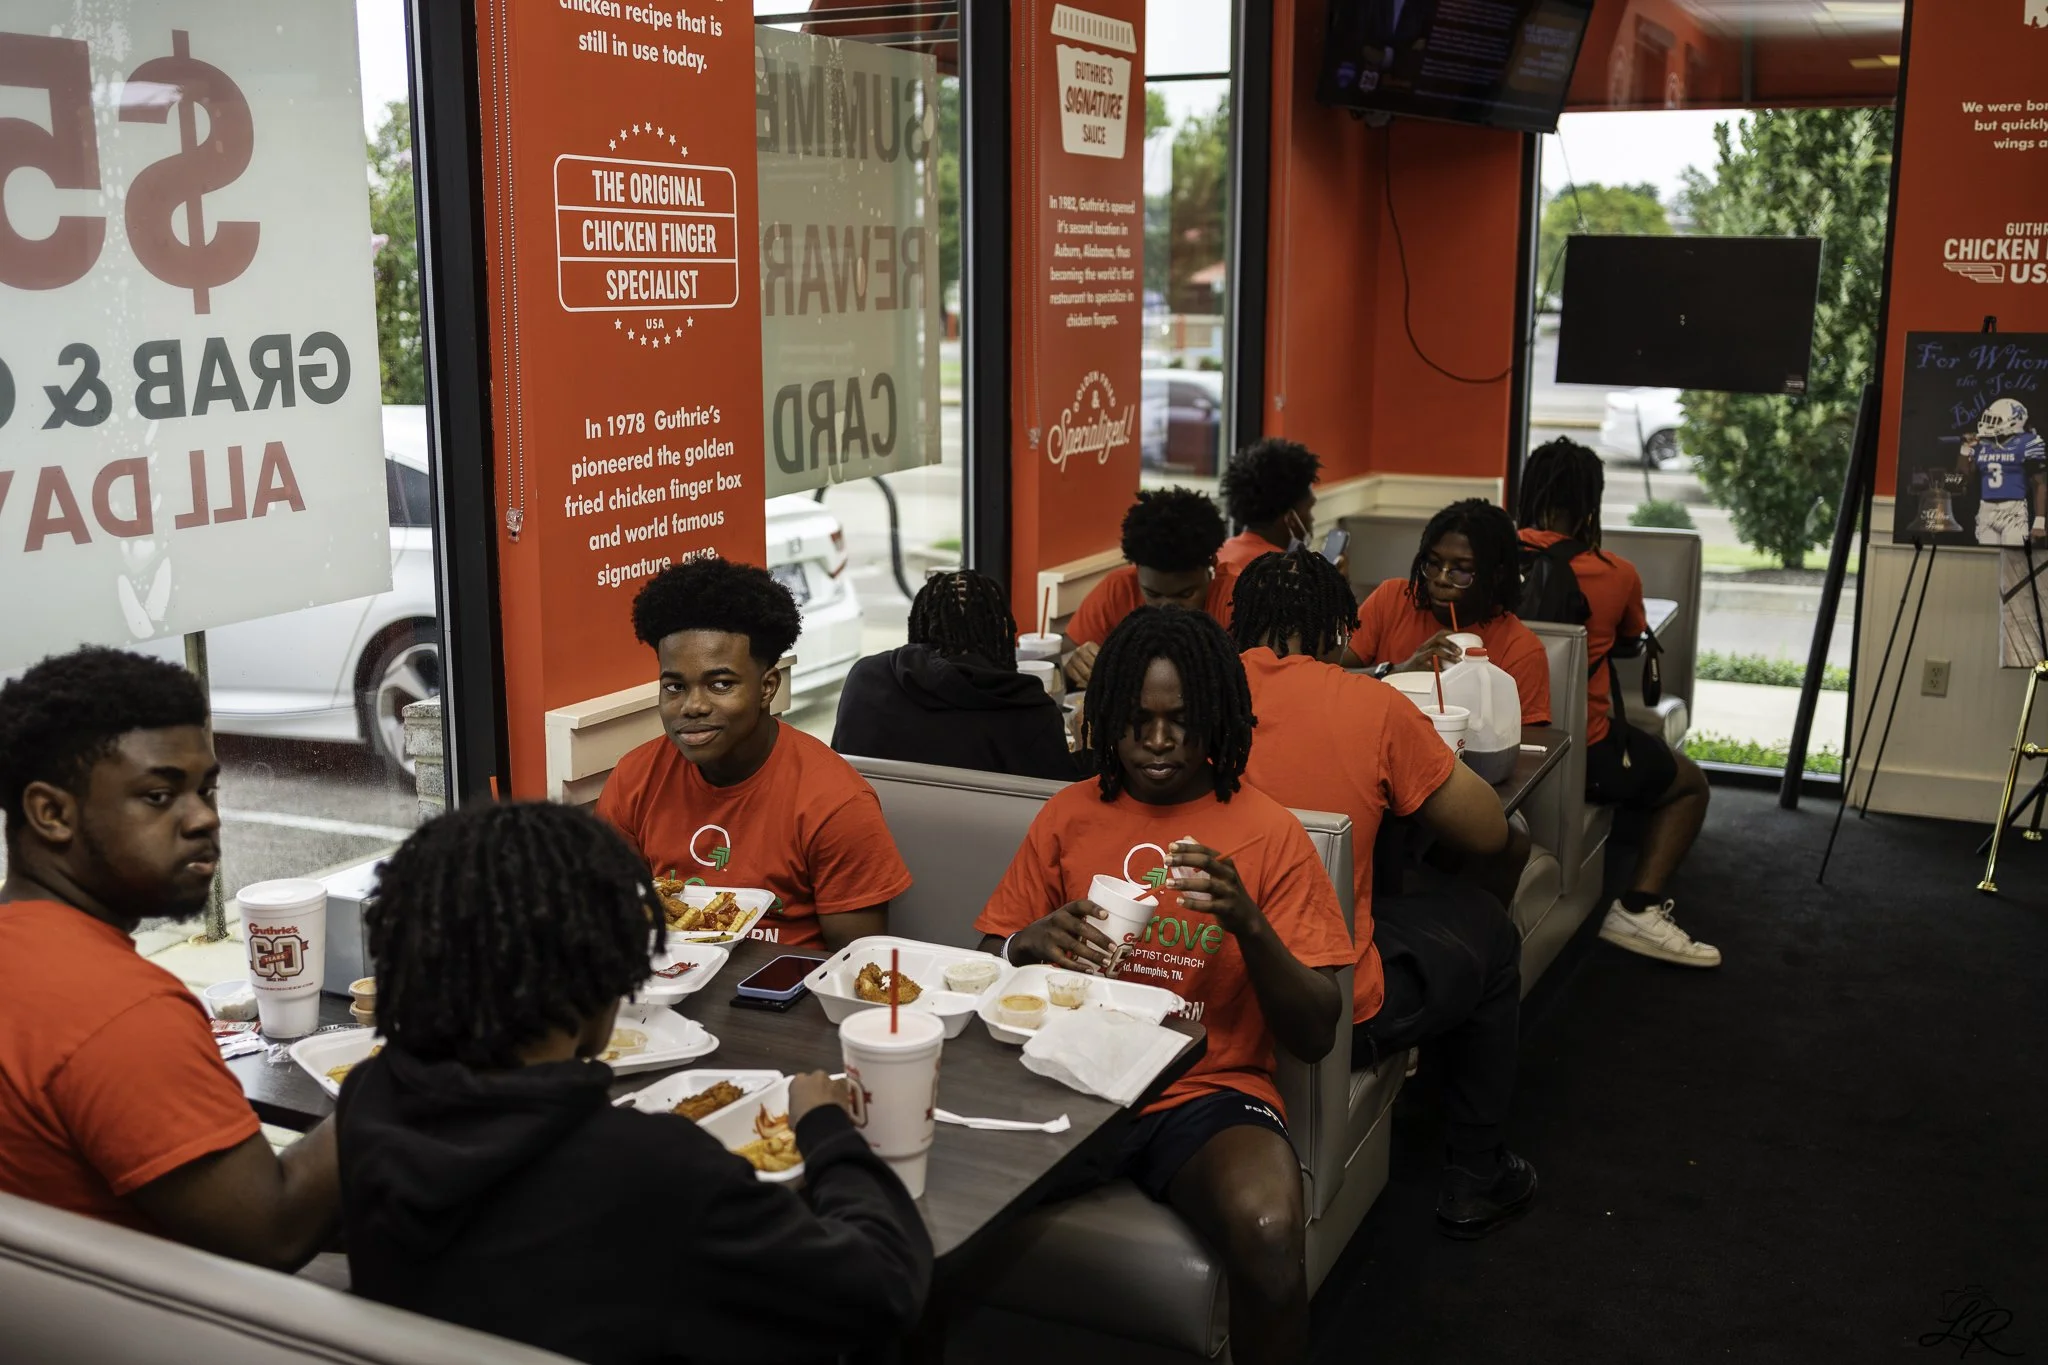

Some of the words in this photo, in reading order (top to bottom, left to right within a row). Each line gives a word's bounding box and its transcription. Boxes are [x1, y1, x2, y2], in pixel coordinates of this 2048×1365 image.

[625, 3, 673, 31] recipe
[676, 9, 706, 34] that
[710, 15, 723, 37] is
[578, 30, 608, 53] still
[612, 33, 628, 57] in
[632, 43, 659, 62] use
[662, 44, 708, 74] today.
[1075, 60, 1113, 86] GUTHRIE'S
[1065, 85, 1124, 120] SIGNATURE
[1962, 101, 1984, 113] We
[1987, 103, 2022, 112] were
[1082, 124, 1106, 145] SAUCE
[1974, 119, 1998, 131] but
[1993, 137, 2035, 151] wings
[591, 170, 625, 203] THE
[630, 172, 705, 207] ORIGINAL
[1049, 195, 1058, 209] In
[1079, 197, 1111, 212] Guthrie's
[1111, 200, 1136, 216] opened
[582, 219, 657, 252] CHICKEN
[661, 223, 717, 253] FINGER
[1069, 220, 1093, 234] second
[1094, 220, 1120, 235] location
[1120, 222, 1129, 235] in
[1054, 242, 1082, 260] Auburn,
[1116, 244, 1131, 258] thus
[1944, 238, 2039, 260] CHICKEN
[606, 269, 699, 301] SPECIALIST
[1049, 266, 1084, 284] becoming
[1084, 266, 1096, 280] the
[1120, 266, 1135, 280] first
[2010, 263, 2048, 284] US
[1049, 291, 1086, 305] restaurant
[1086, 291, 1094, 303] to
[1095, 289, 1127, 307] specialize
[1127, 289, 1134, 302] in
[645, 318, 665, 329] USA
[1066, 312, 1093, 328] chicken
[1917, 342, 1960, 369] For
[1956, 374, 1978, 387] the
[1986, 372, 2038, 395] Tolls
[1949, 391, 1987, 429] Bell
[585, 418, 602, 439] In
[607, 412, 645, 437] 1978
[654, 405, 721, 431] Guthrie's
[1047, 404, 1136, 473] Specialized!
[571, 446, 653, 485] pioneered
[657, 444, 681, 466] the
[685, 438, 734, 467] golden
[1977, 453, 2015, 462] MEMPHIS
[1987, 462, 2003, 489] 3
[564, 490, 604, 518] fried
[608, 484, 666, 511] chicken
[669, 478, 713, 501] finger
[717, 471, 743, 491] box
[589, 524, 621, 551] and
[624, 516, 668, 543] world
[671, 510, 725, 534] famous
[597, 555, 672, 588] signature
[248, 923, 299, 935] Guthrie's
[1143, 915, 1225, 954] rove
[1130, 949, 1162, 961] APTIST
[1163, 953, 1205, 968] CHURCH
[1133, 963, 1170, 979] Memphis,
[1171, 970, 1184, 980] TN.
